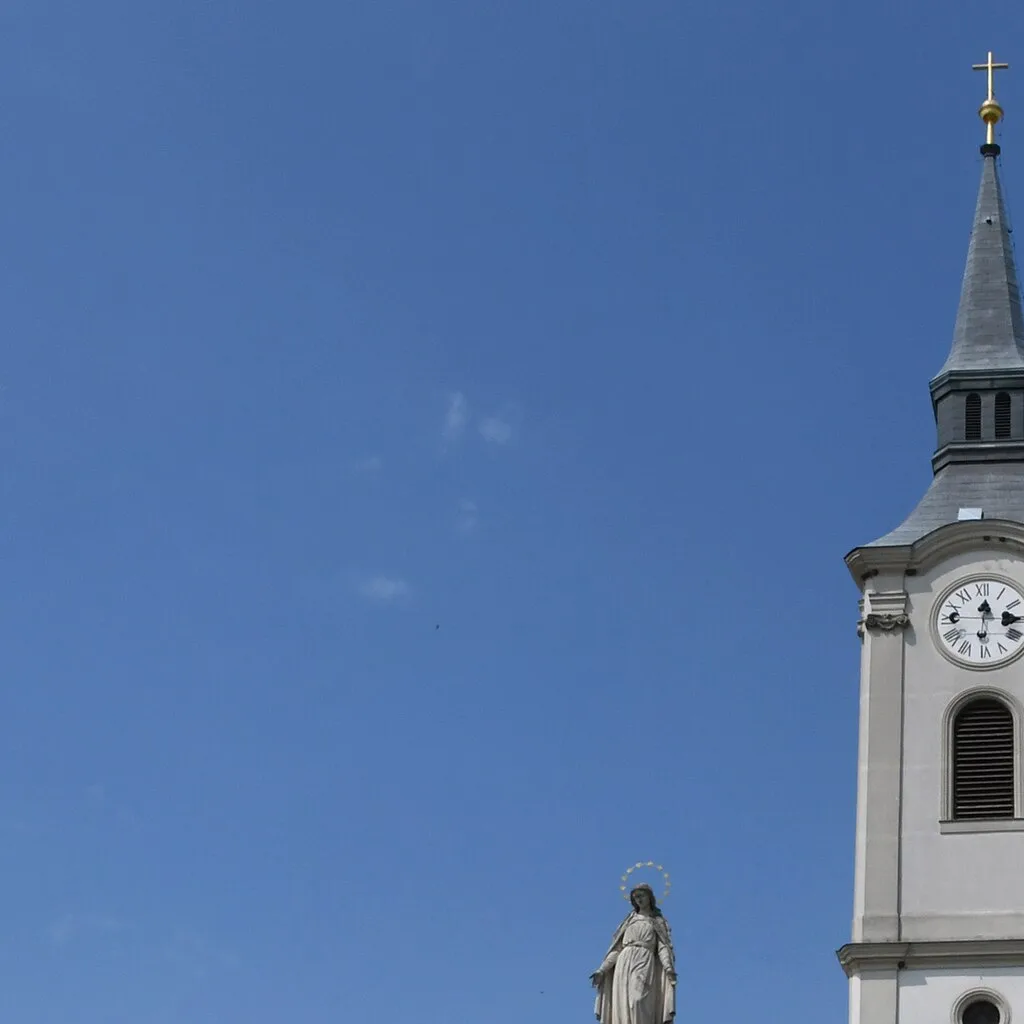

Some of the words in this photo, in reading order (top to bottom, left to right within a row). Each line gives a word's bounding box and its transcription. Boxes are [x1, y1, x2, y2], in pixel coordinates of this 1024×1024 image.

[956, 588, 972, 604] XI
[976, 583, 990, 596] XII
[946, 600, 961, 613] X
[1006, 599, 1021, 610] II
[958, 640, 971, 657] VII
[980, 645, 991, 658] VI
[997, 642, 1008, 654] V
